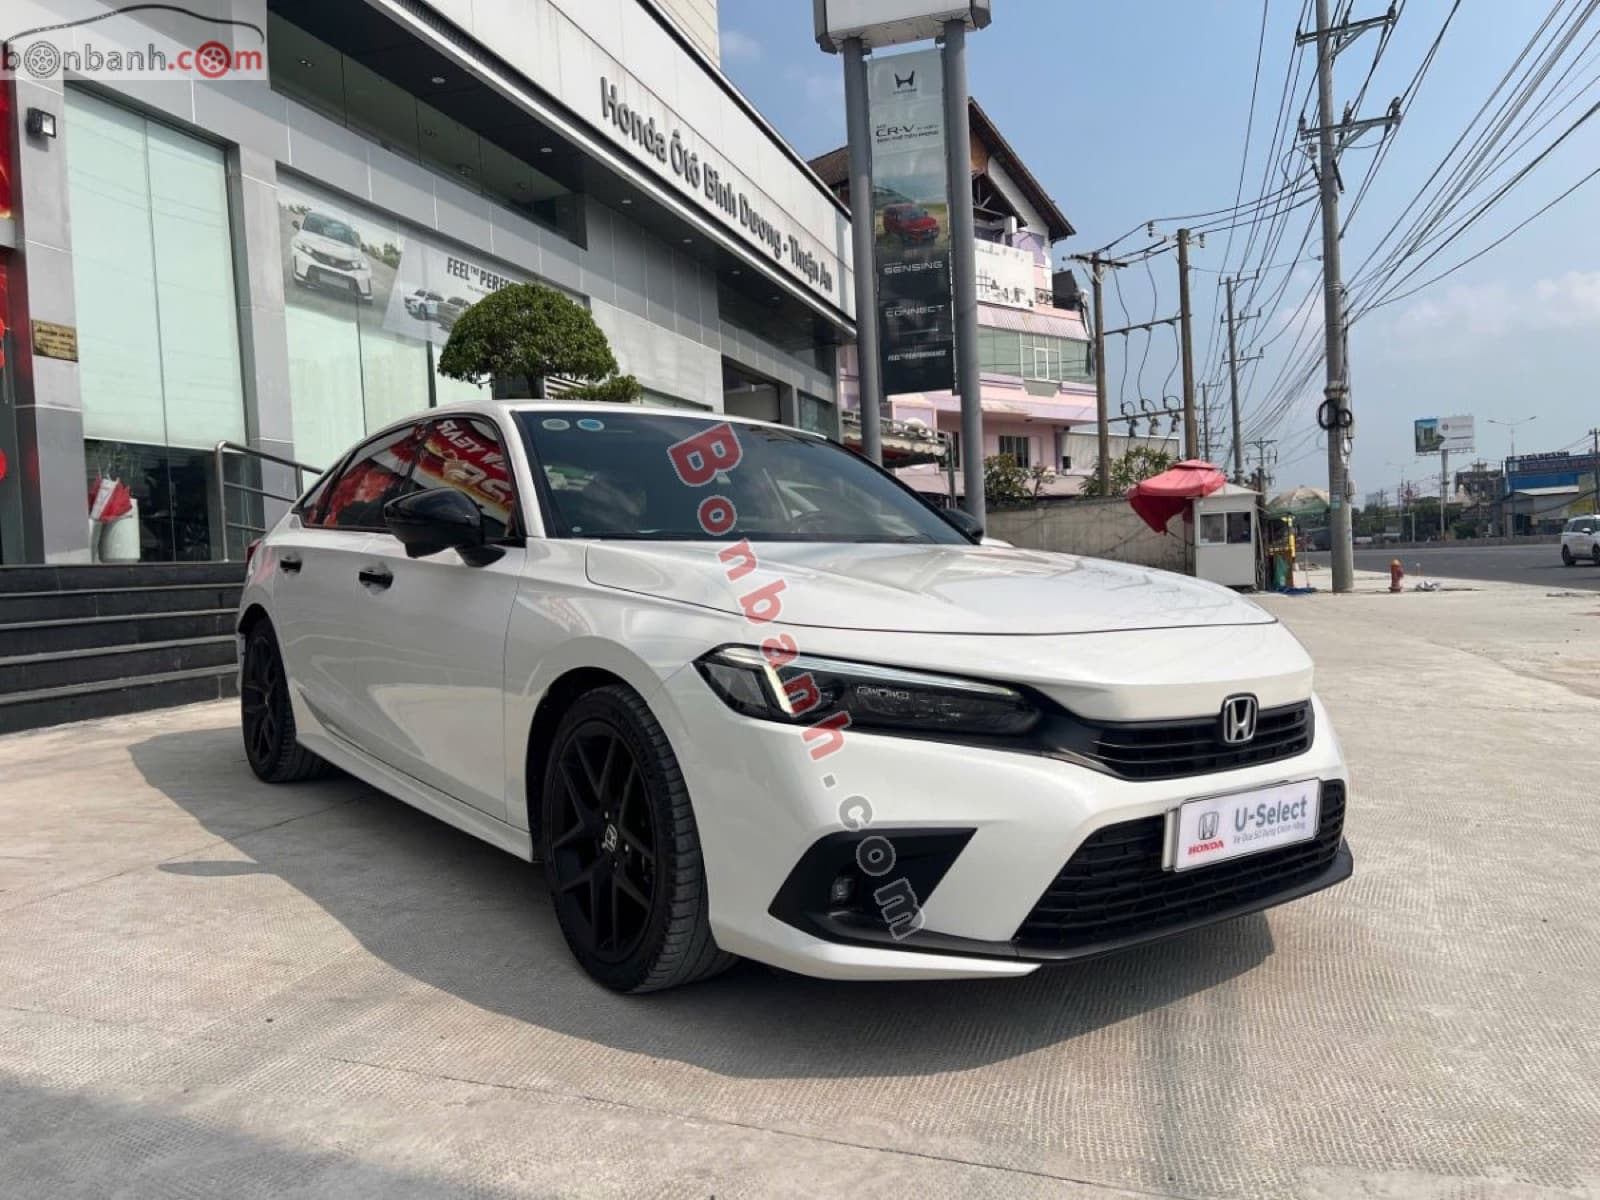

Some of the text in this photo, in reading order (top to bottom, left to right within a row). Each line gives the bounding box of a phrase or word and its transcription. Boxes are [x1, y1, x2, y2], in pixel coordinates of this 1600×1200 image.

[876, 124, 914, 137] CR-V
[600, 76, 667, 165] Honda
[670, 129, 700, 189] Ôtô
[703, 162, 737, 219] Bình
[788, 234, 819, 284] Thuận
[819, 261, 832, 292] An
[447, 256, 470, 281] FEEL
[884, 260, 943, 274] SENSING
[886, 304, 945, 318] CONNECT
[1234, 795, 1307, 832] U-Select
[1188, 840, 1224, 856] HONDA
